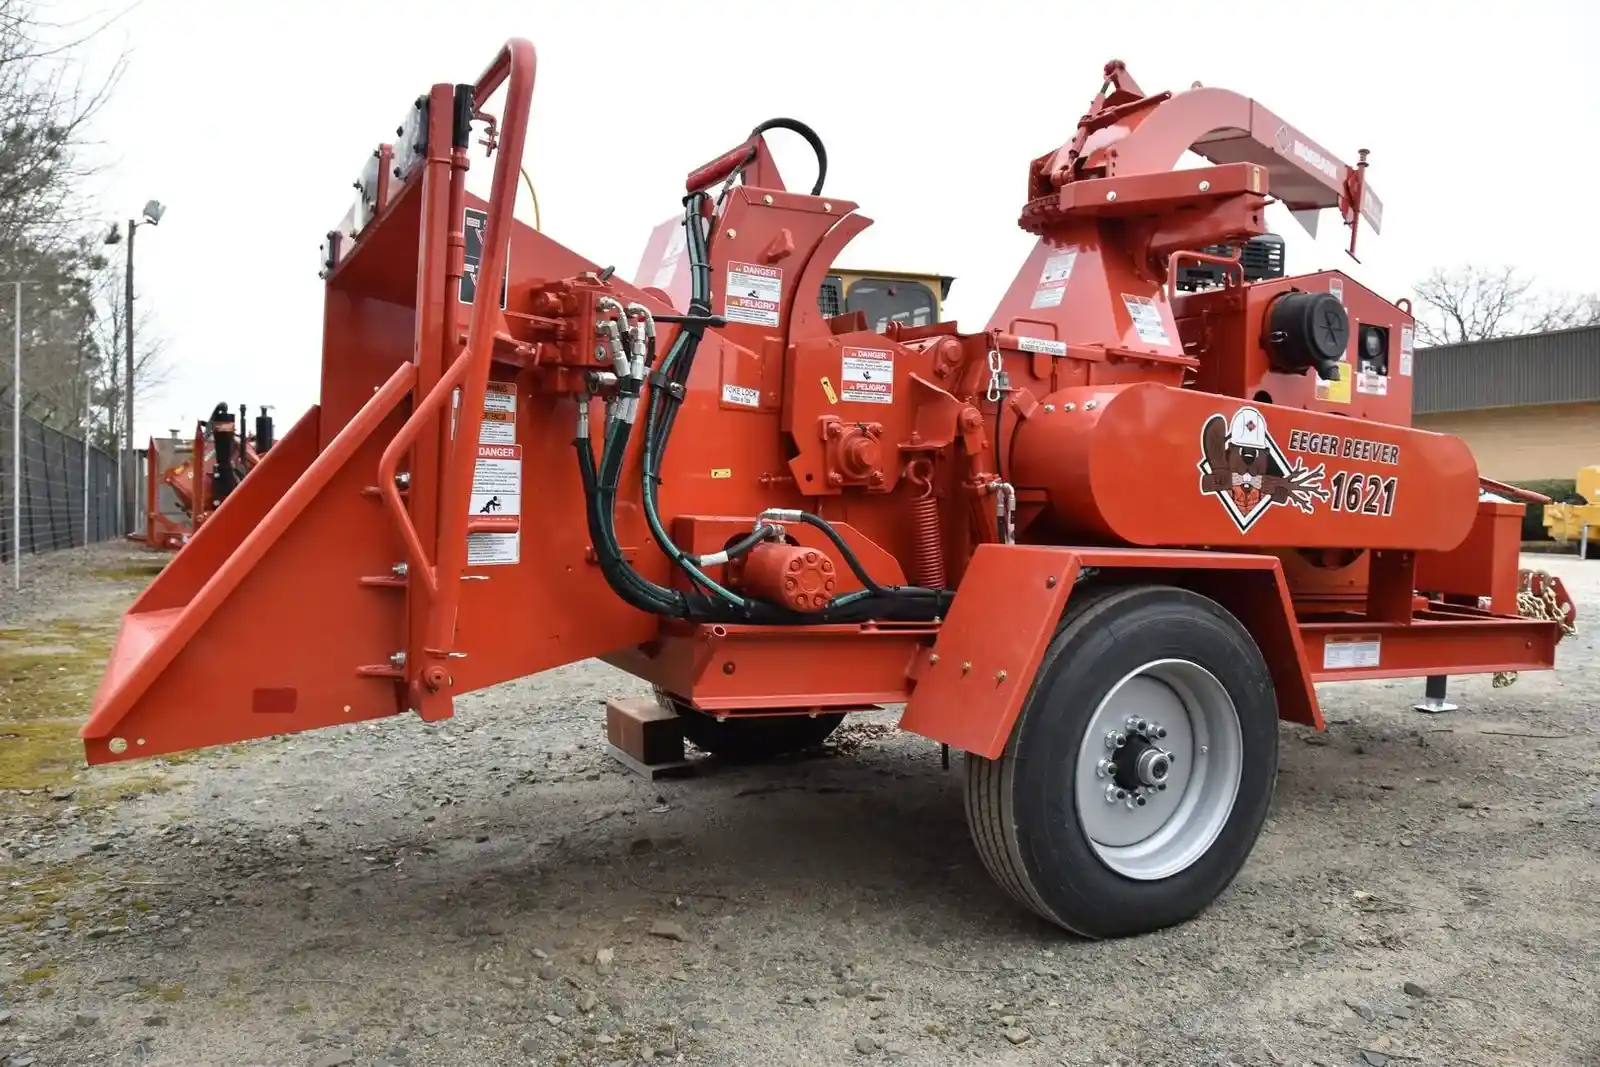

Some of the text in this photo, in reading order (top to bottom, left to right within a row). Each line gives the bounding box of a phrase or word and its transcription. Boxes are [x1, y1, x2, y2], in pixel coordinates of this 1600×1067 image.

[743, 265, 777, 277] DANGER
[740, 299, 776, 311] PELIGRO
[857, 351, 887, 360] DANGER
[856, 383, 887, 392] PELIGRO
[478, 447, 514, 457] DANGER
[1288, 429, 1400, 464] EEGER BEEVER
[1331, 471, 1398, 516] 1621
